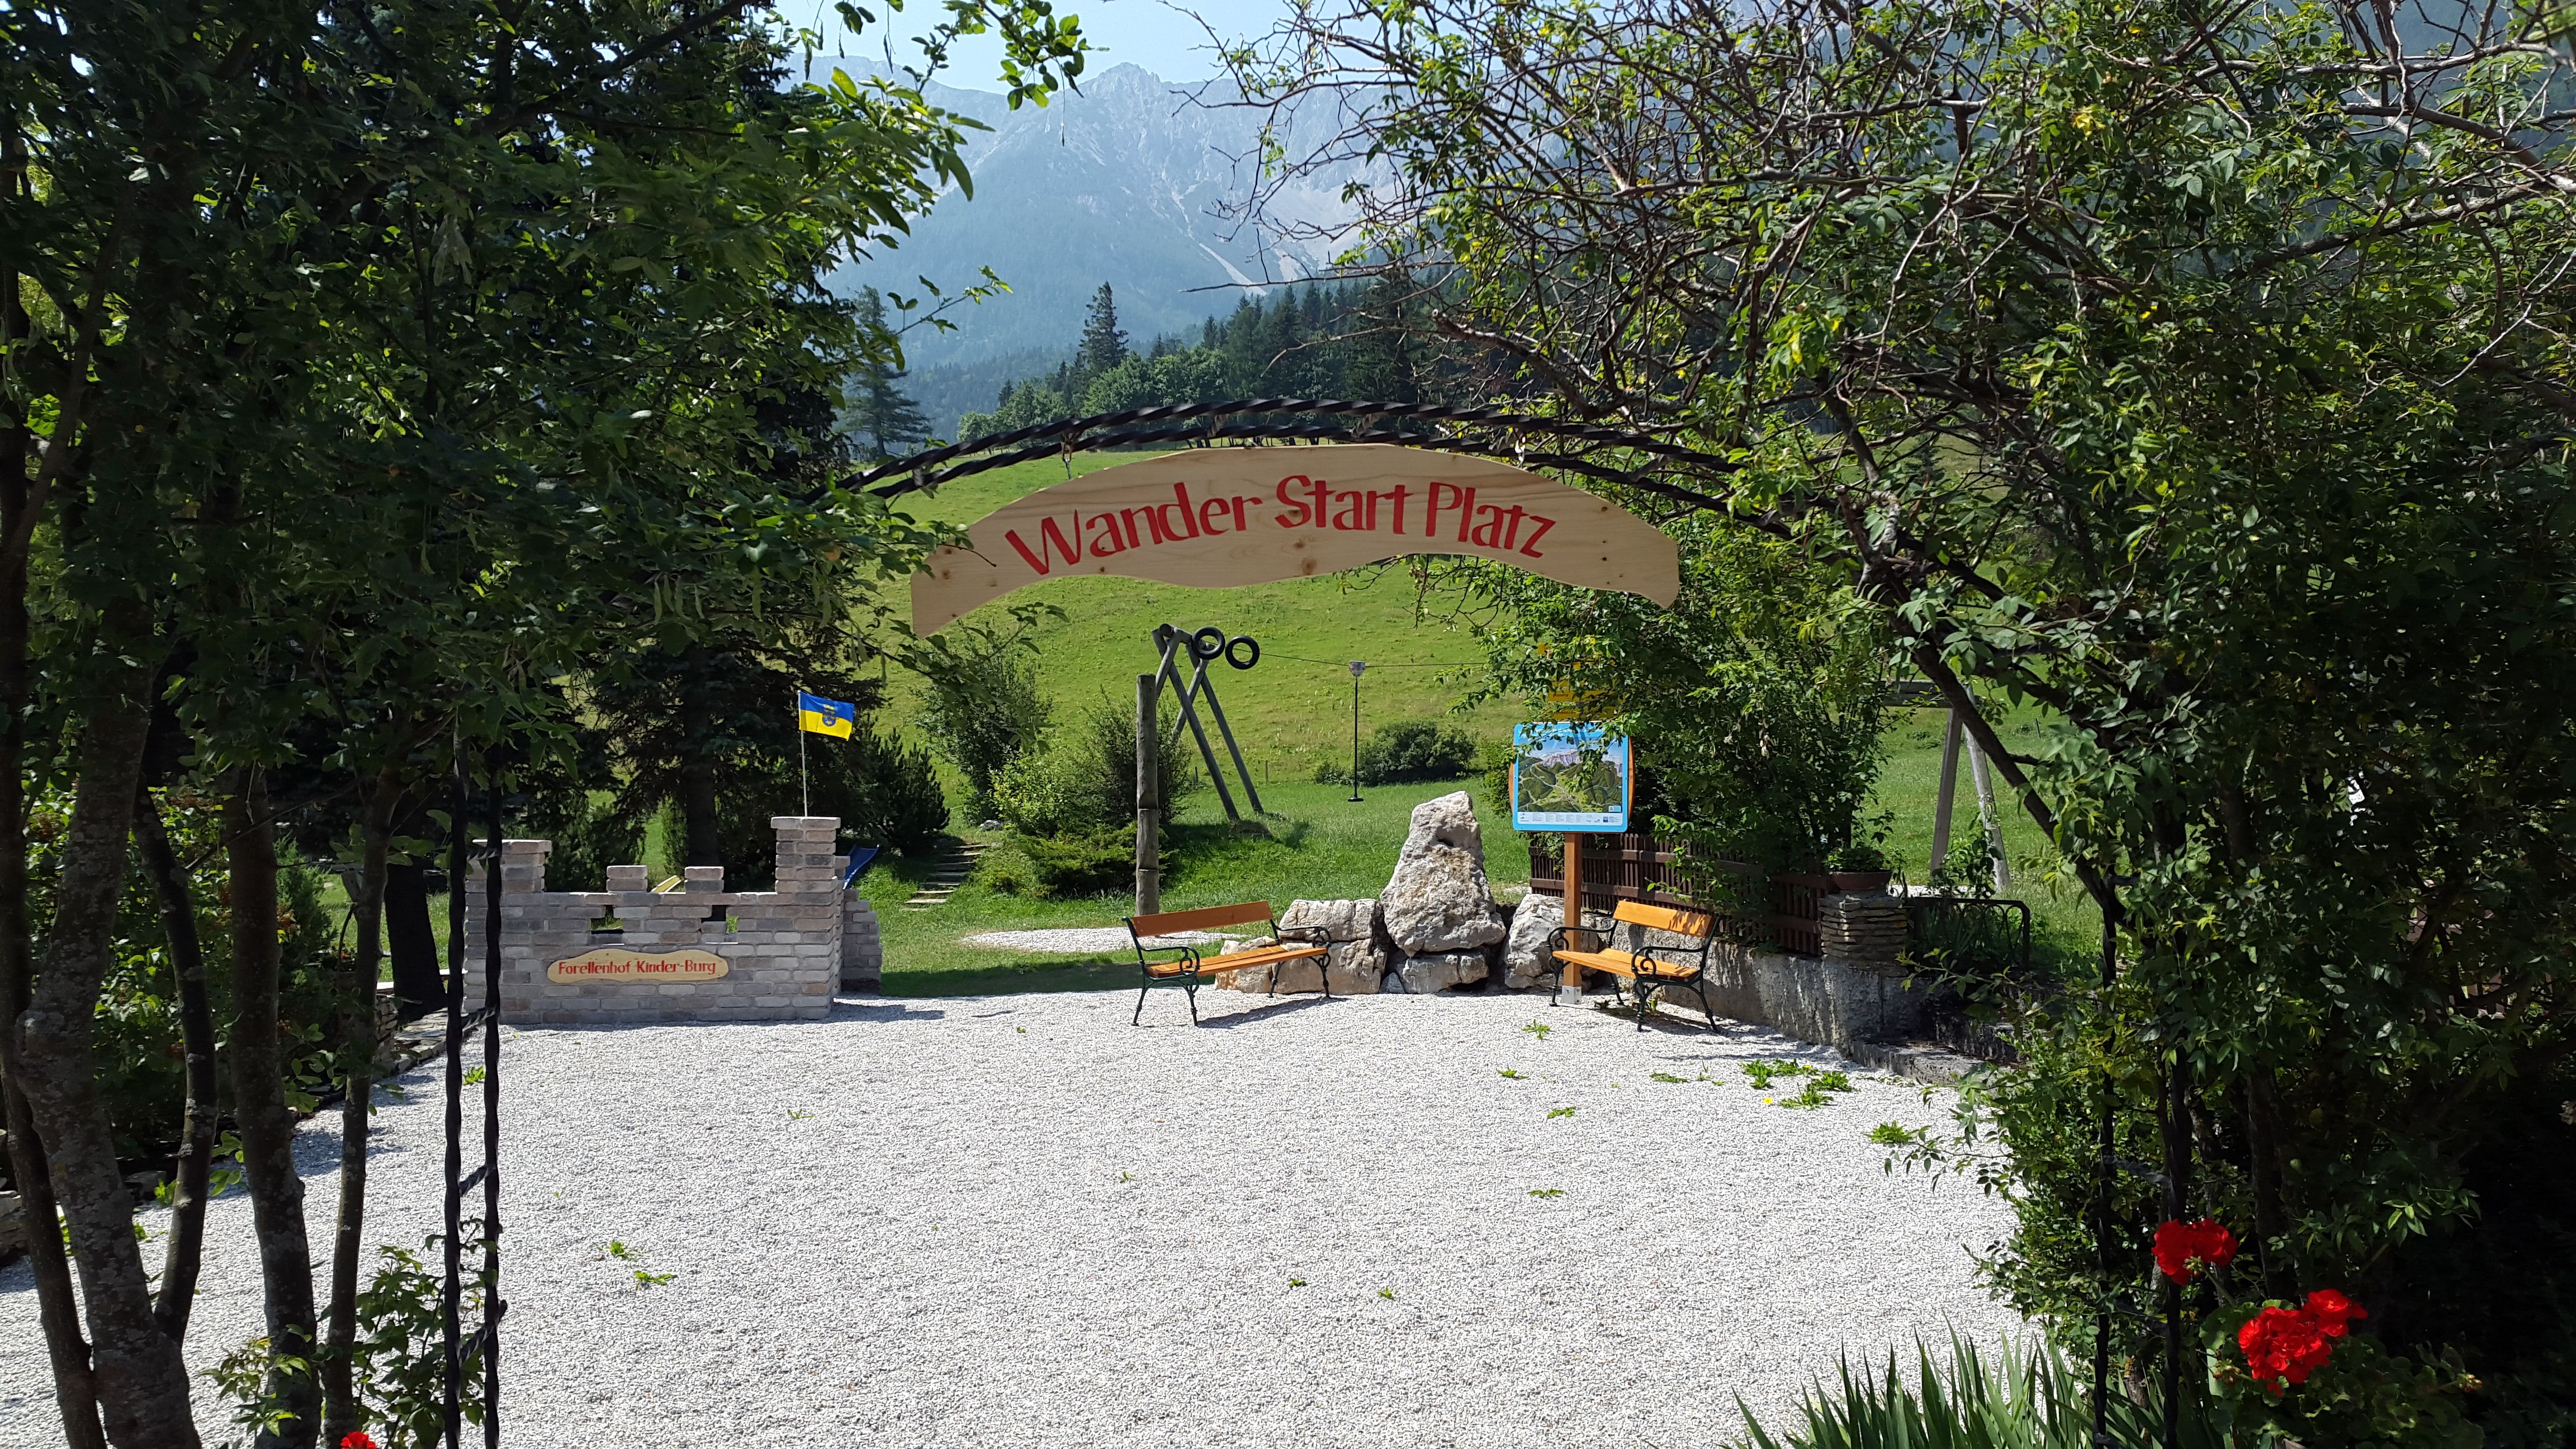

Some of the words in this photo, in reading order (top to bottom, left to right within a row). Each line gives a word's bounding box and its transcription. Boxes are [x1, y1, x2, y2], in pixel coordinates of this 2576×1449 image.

[1005, 481, 1263, 576] Wander
[1275, 475, 1412, 536] Start
[1425, 481, 1556, 558] Platz
[558, 960, 632, 975] Forellenhof
[636, 959, 716, 975] Kinder-Burg
